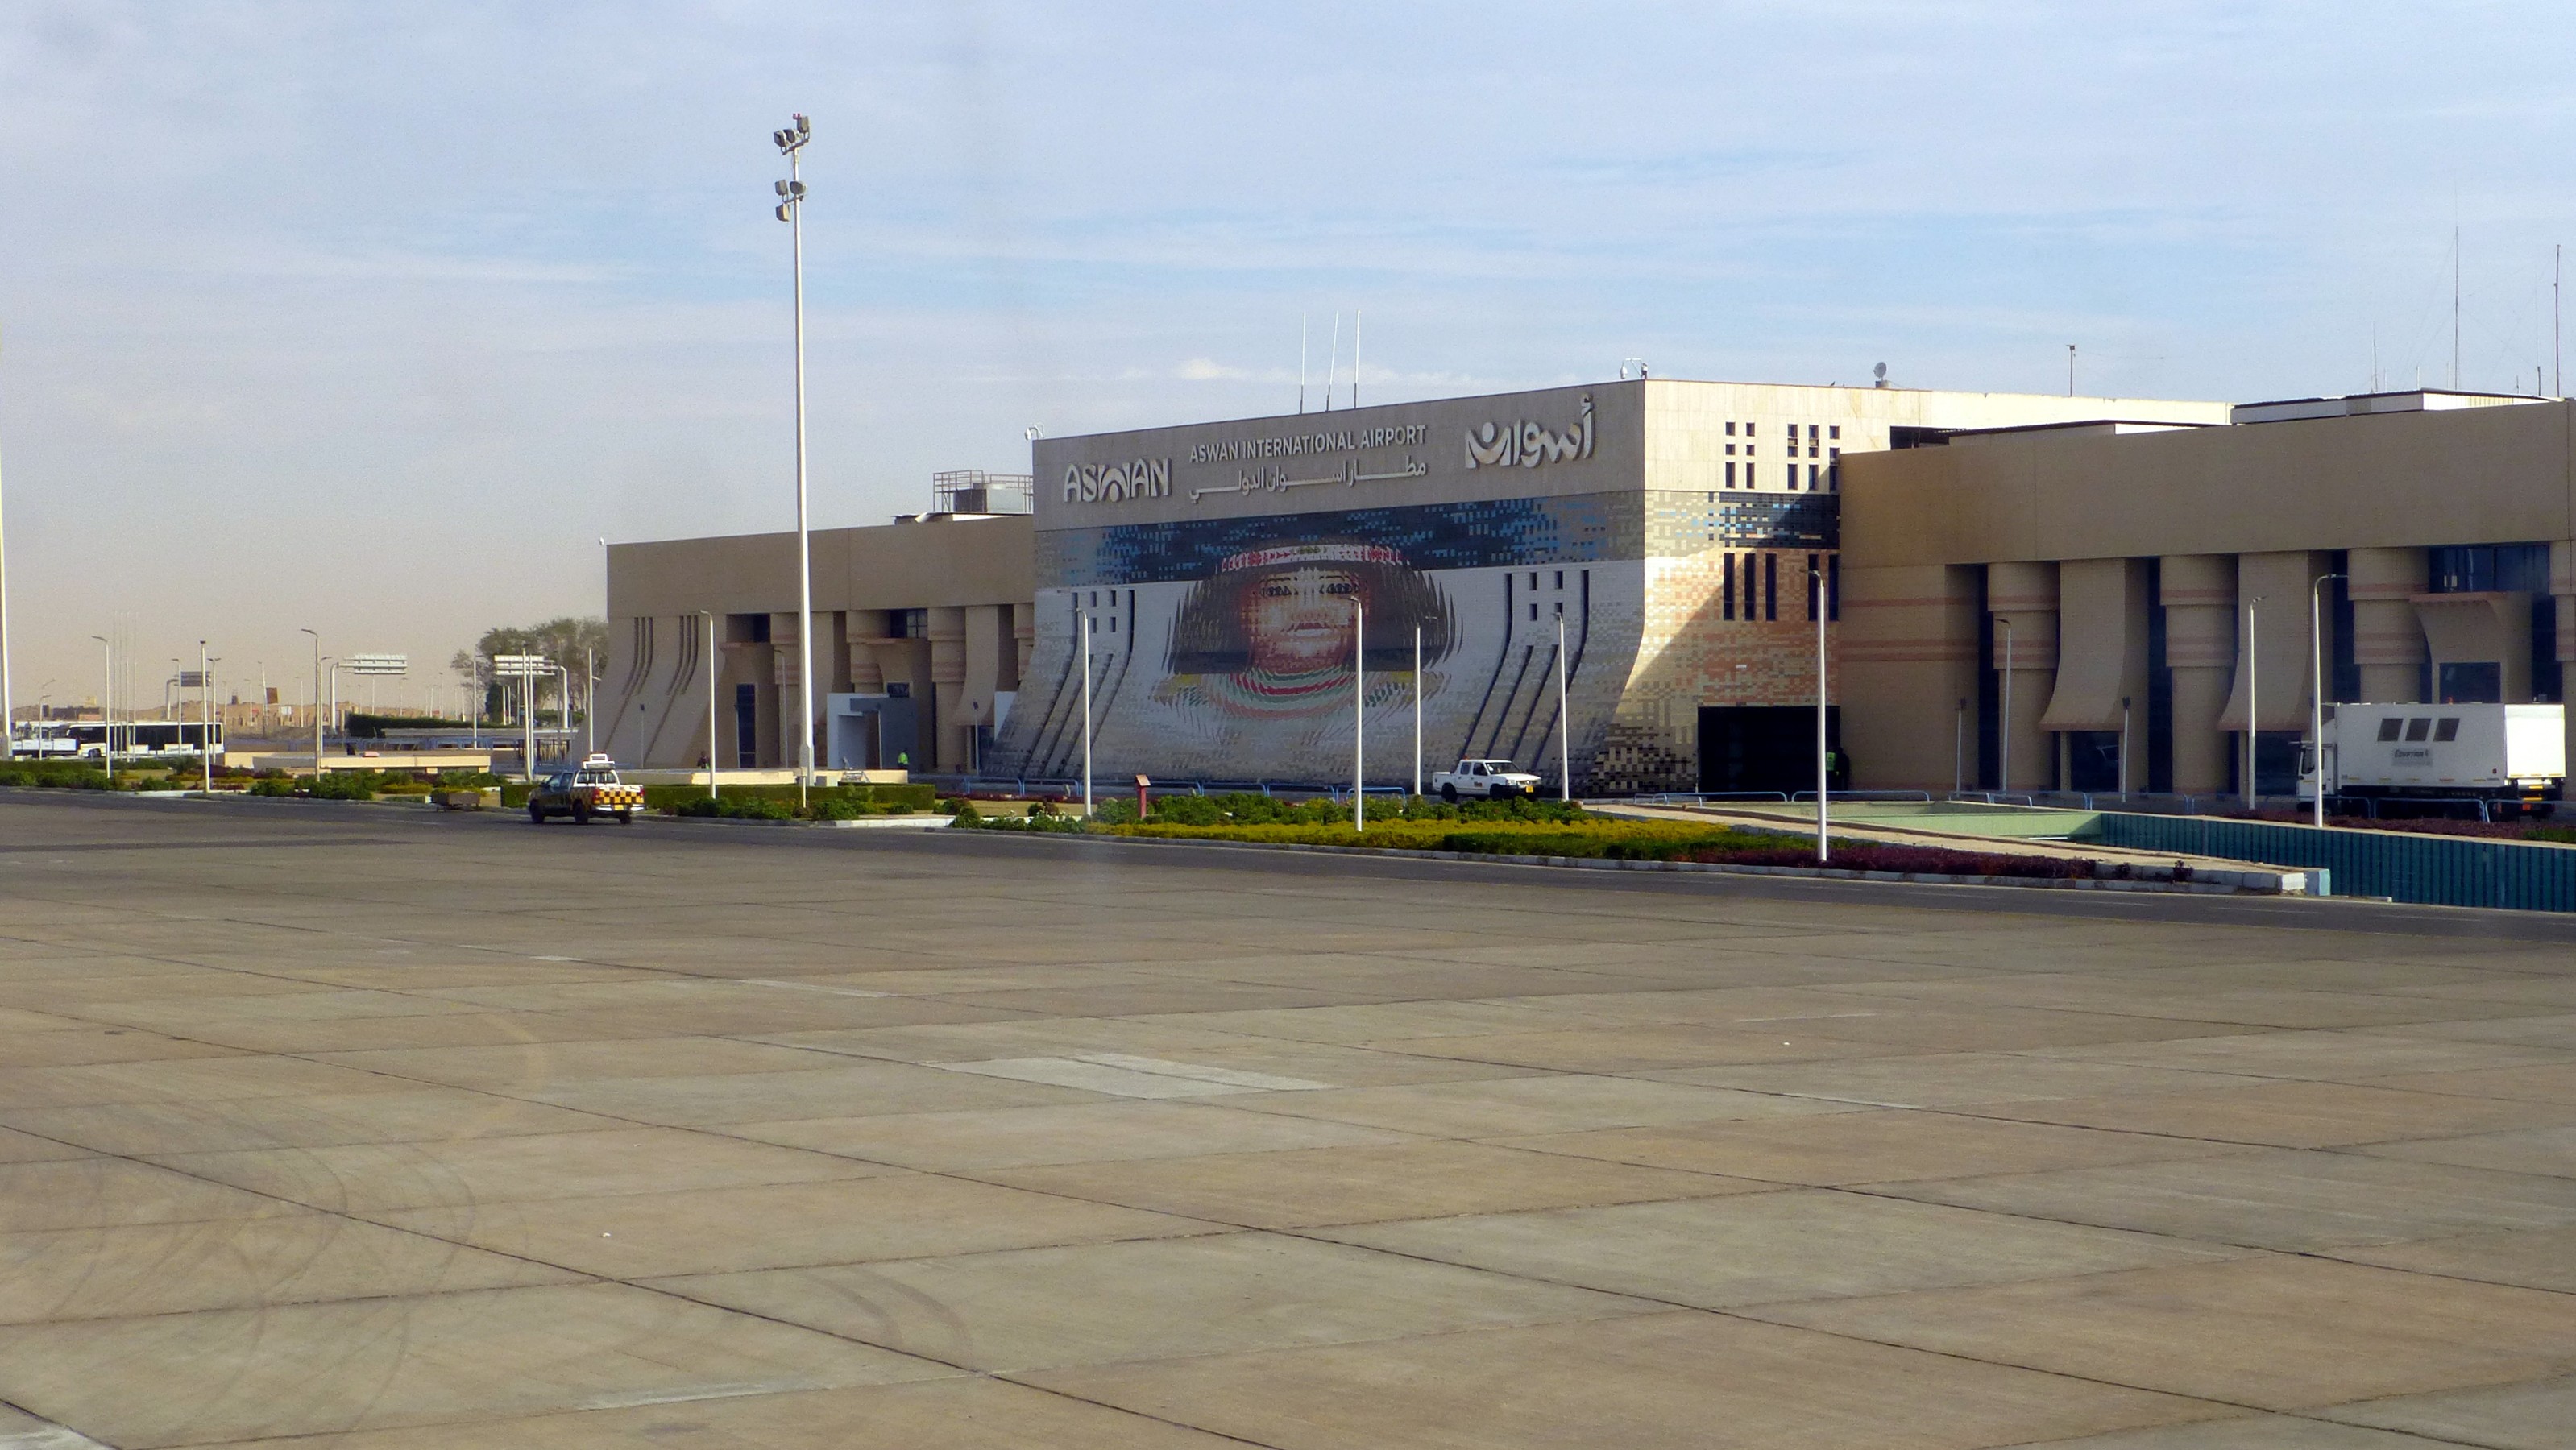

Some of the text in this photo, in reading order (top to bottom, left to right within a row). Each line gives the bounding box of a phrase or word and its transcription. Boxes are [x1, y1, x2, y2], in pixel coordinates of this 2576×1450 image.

[1189, 425, 1426, 463] ASWAN INTERNATIONAL AIRPORT
[1064, 458, 1172, 503] ASWAN
[1349, 455, 1427, 487] مطار
